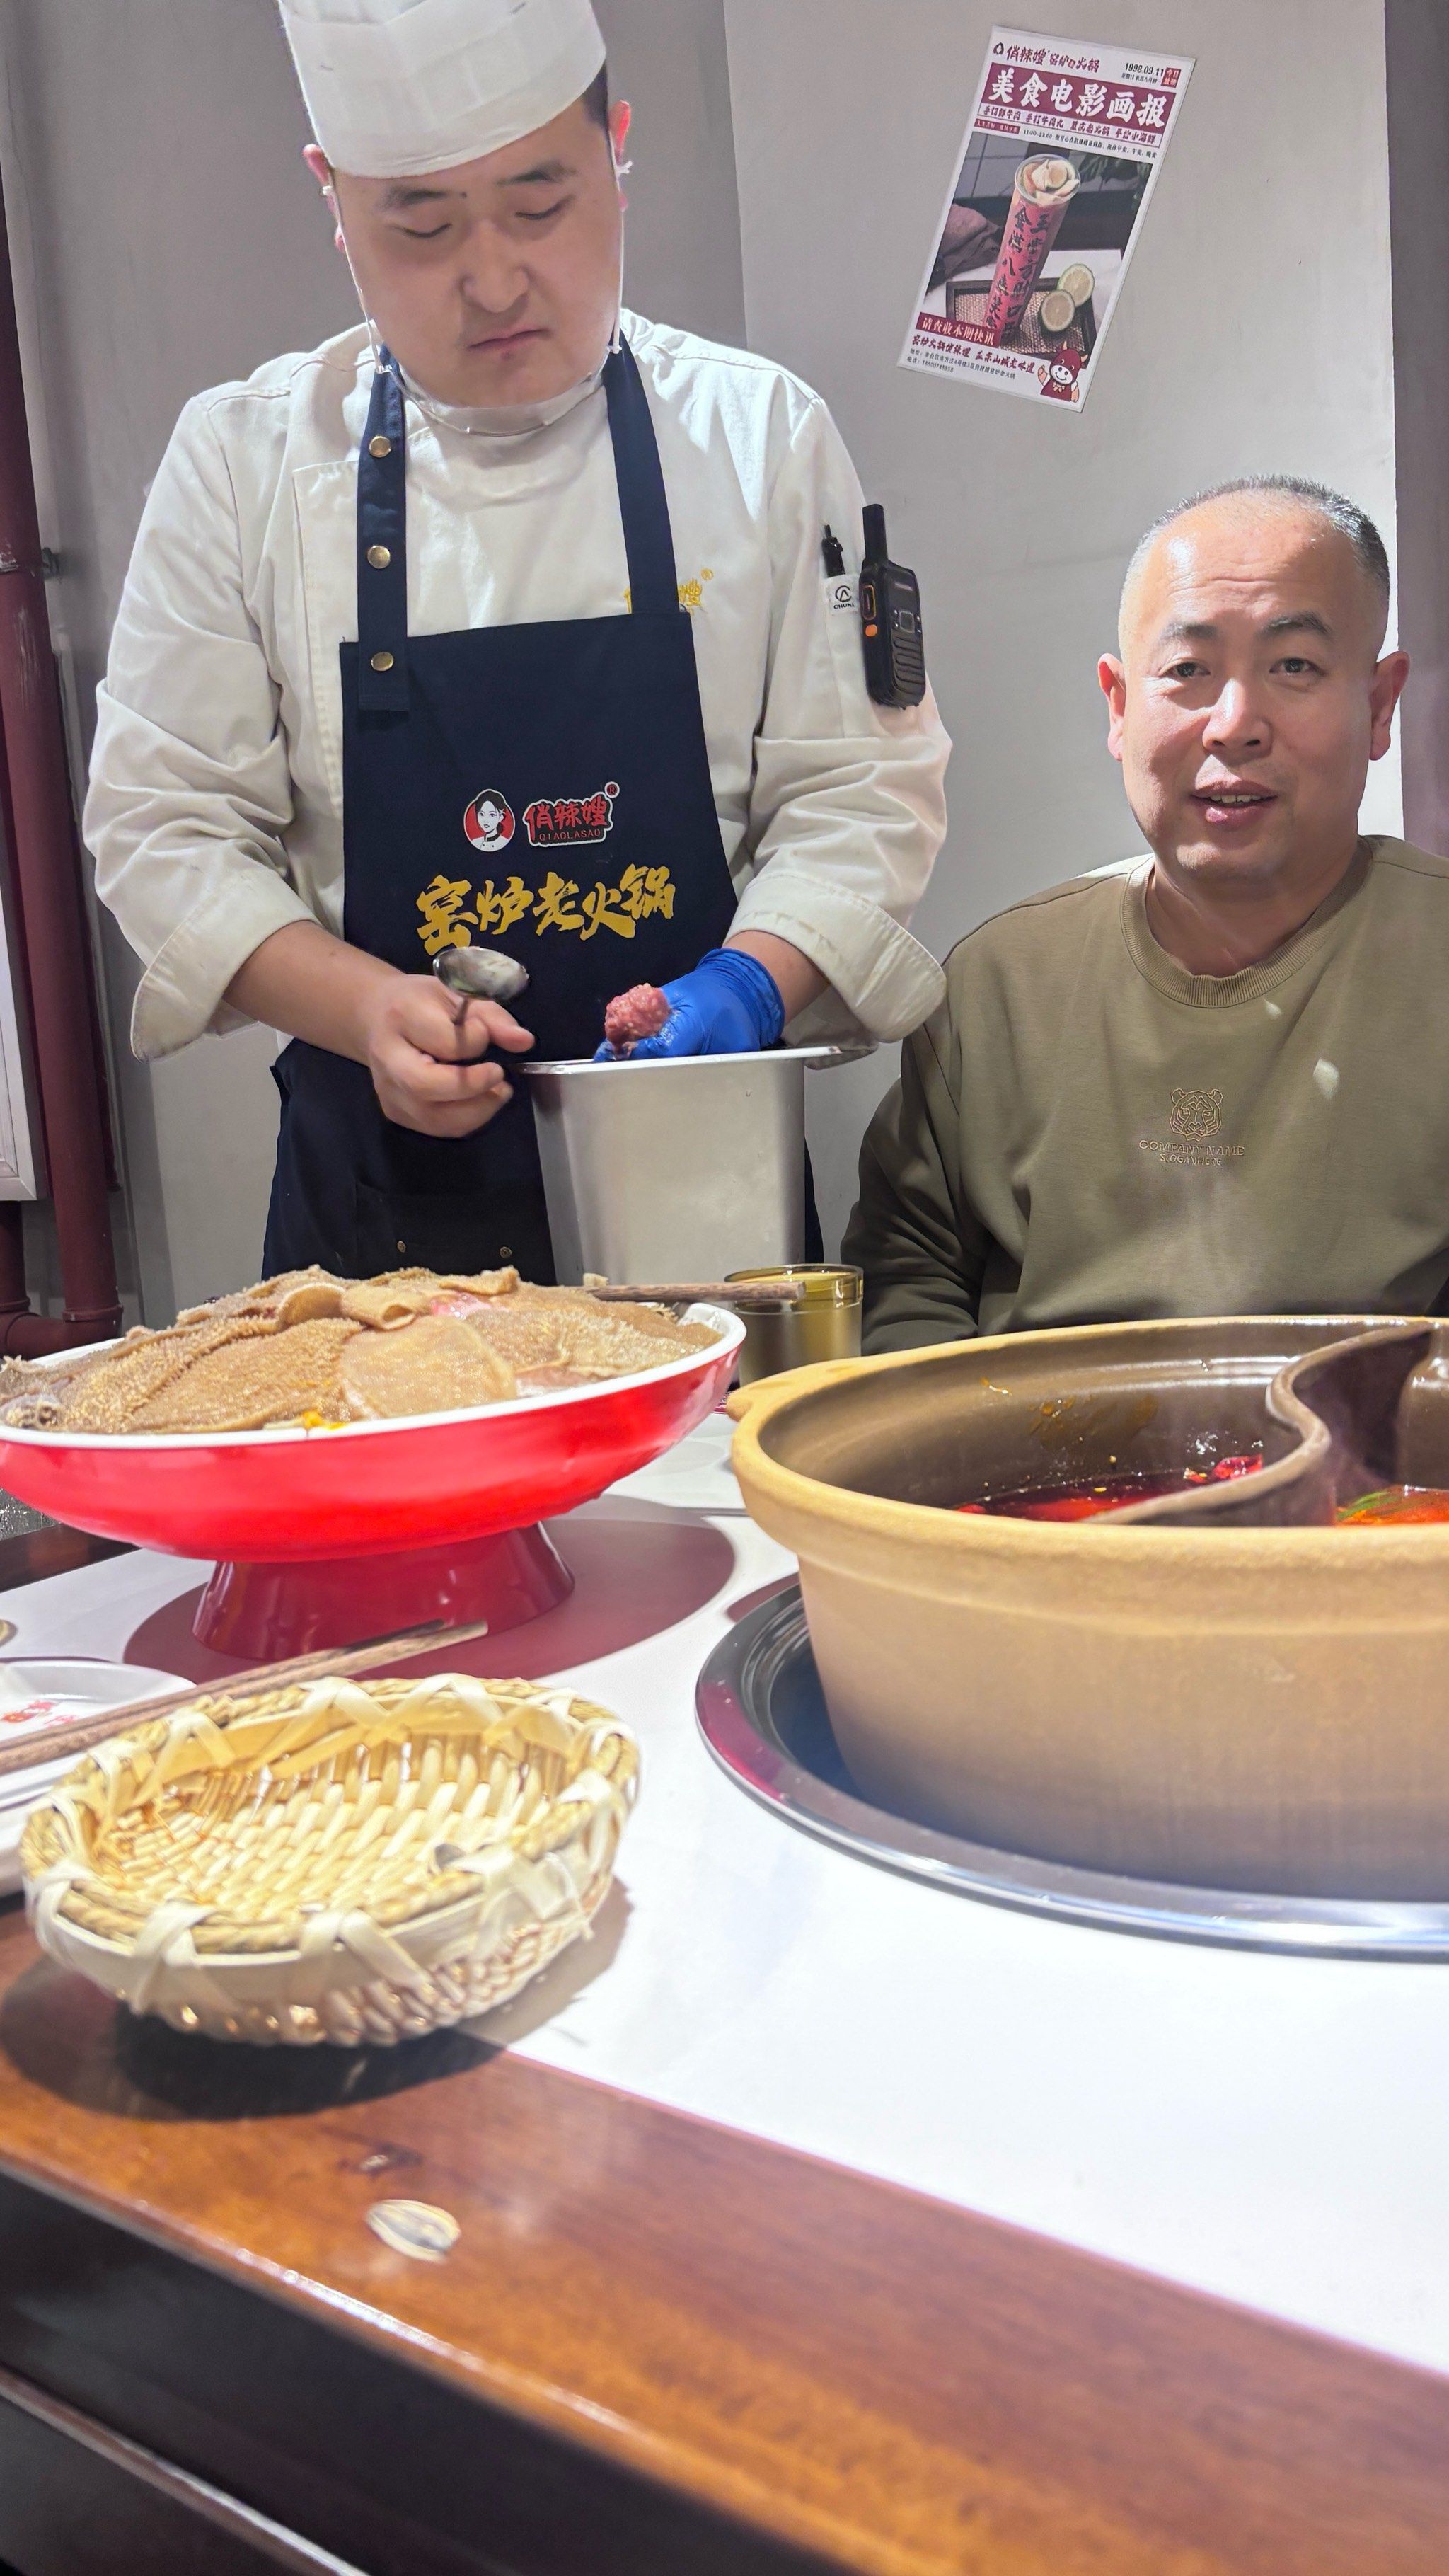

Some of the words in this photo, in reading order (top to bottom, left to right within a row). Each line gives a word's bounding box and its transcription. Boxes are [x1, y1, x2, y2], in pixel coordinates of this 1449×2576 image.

[1006, 45, 1046, 65] 俏辣嫂
[1125, 62, 1163, 76] 1998.09.11
[988, 68, 1166, 127] 美食电影画报
[1025, 113, 1063, 127] 手打牛肉丸
[922, 317, 994, 345] 请查收本期快讯
[526, 795, 608, 841] 俏辣嫂
[538, 828, 601, 841] QIAOLASAO
[416, 863, 676, 956] 窑炉老火锅
[1139, 1139, 1202, 1155] COMPANY
[1206, 1145, 1245, 1156] NAME
